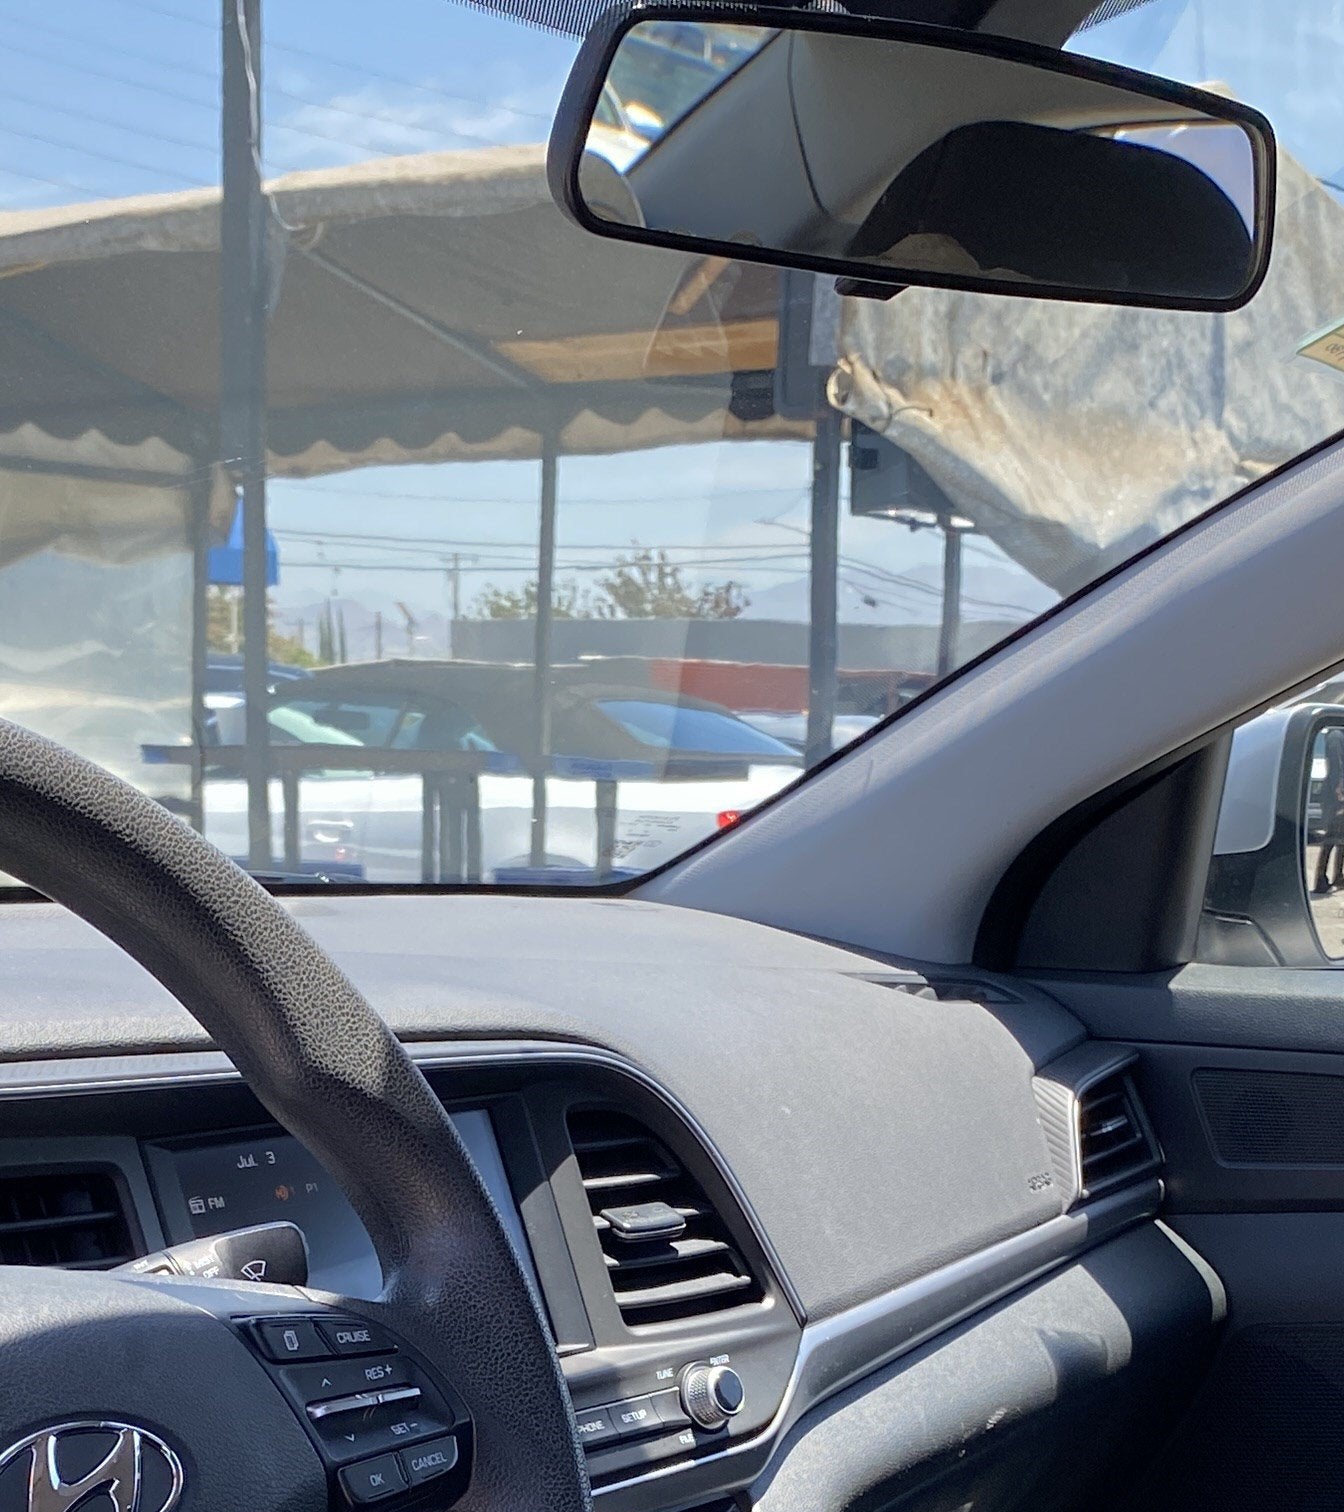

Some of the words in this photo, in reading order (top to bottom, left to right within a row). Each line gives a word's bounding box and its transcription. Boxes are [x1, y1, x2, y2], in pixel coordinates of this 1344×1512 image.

[265, 1151, 276, 1165] 3
[208, 1196, 225, 1210] FM
[203, 1266, 220, 1279] OFF
[337, 1329, 371, 1344] CRUISE
[656, 1367, 674, 1380] TUNE
[622, 1409, 647, 1424] SETUP
[412, 1453, 448, 1471] CANCEL
[369, 1473, 385, 1487] OK
